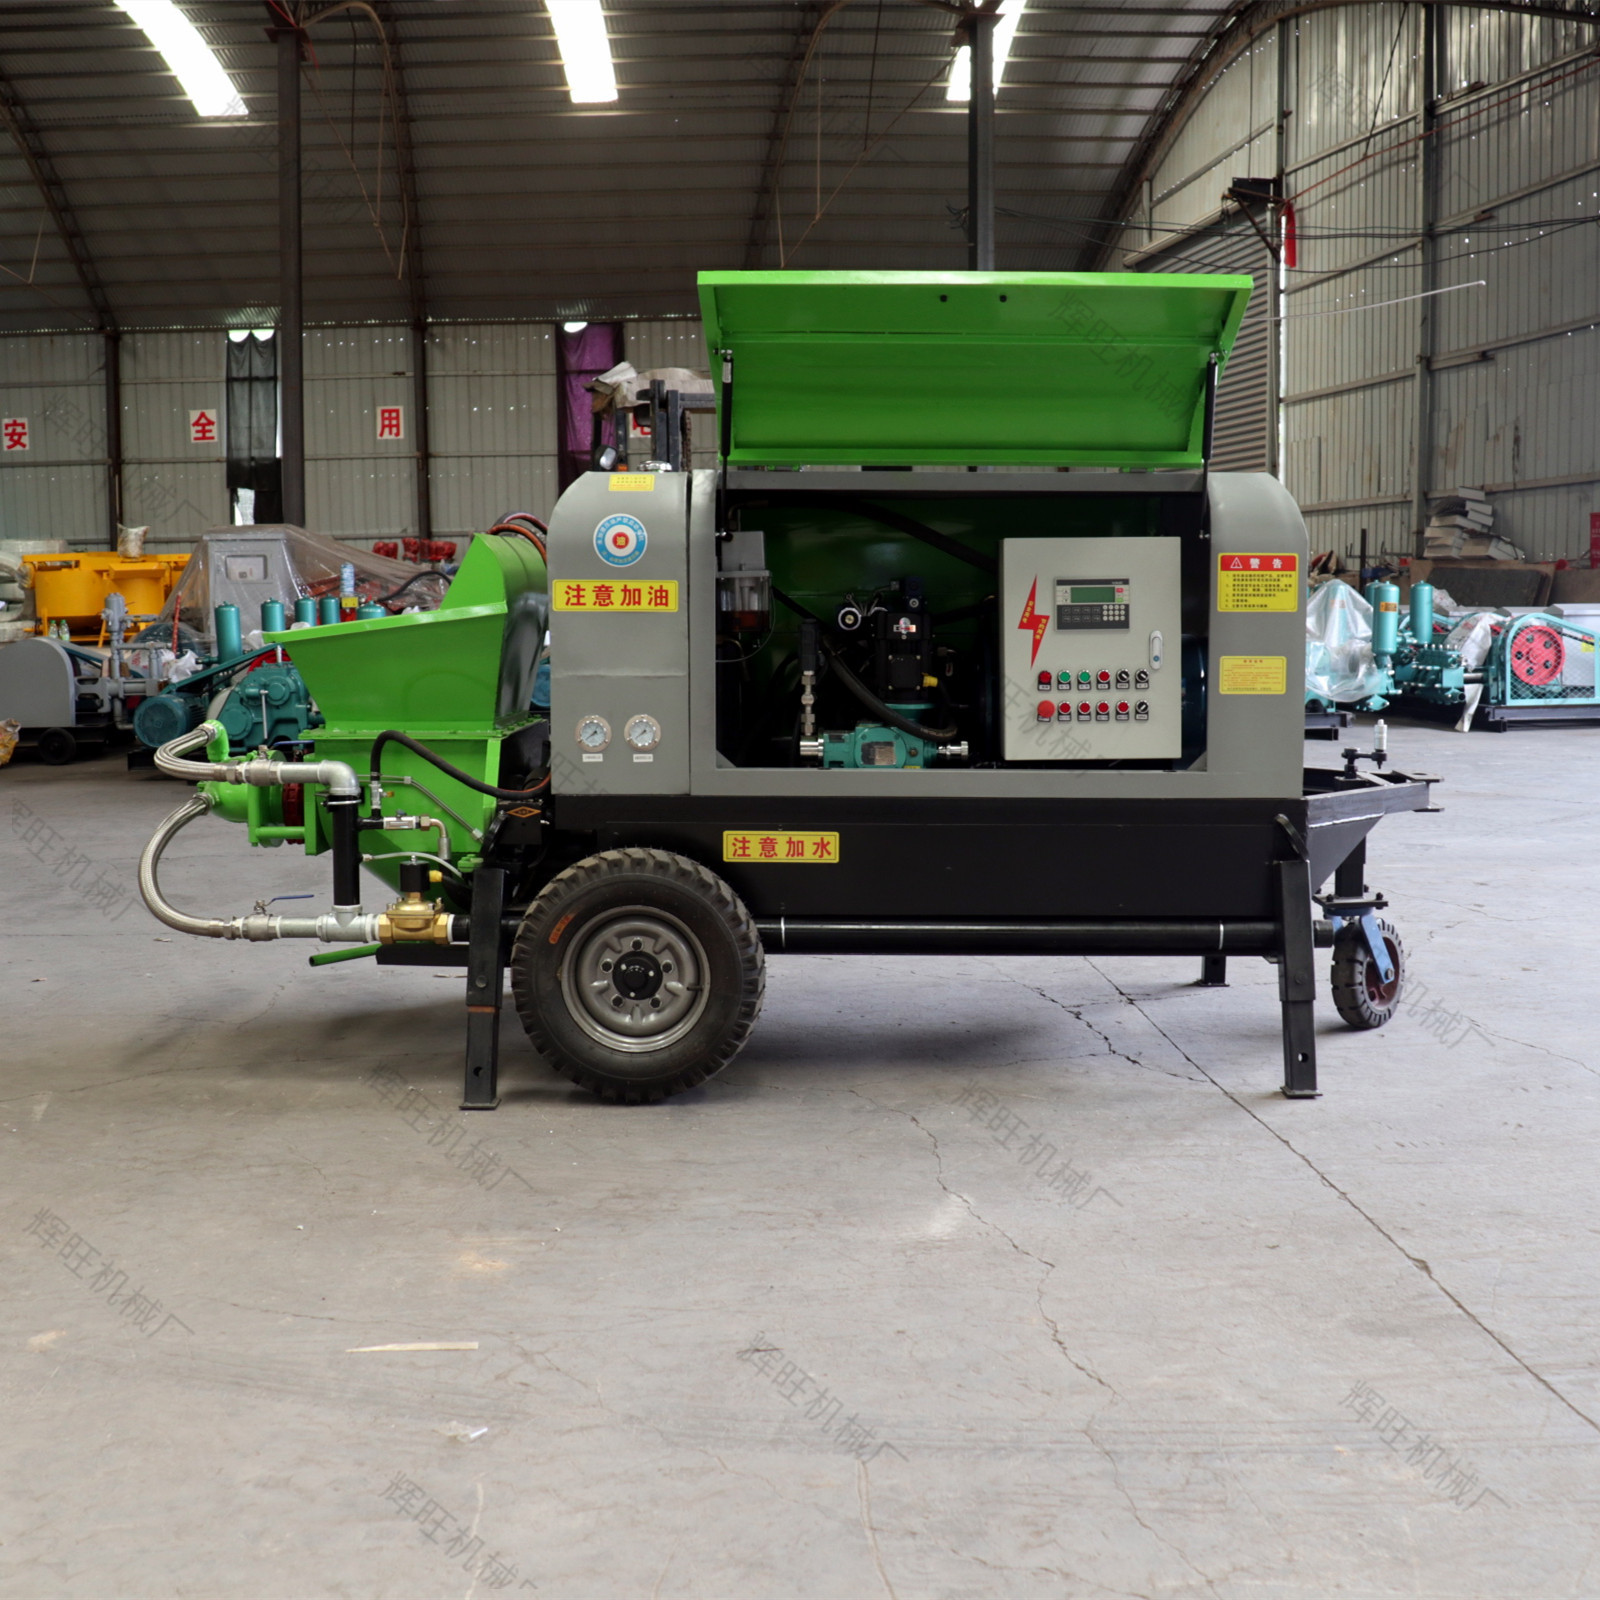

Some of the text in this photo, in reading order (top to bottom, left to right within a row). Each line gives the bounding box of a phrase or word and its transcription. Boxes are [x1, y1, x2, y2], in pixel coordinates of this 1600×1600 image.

[4, 408, 400, 450] 安 全 用
[564, 584, 669, 607] 注意加油
[732, 836, 832, 859] 注意加水
